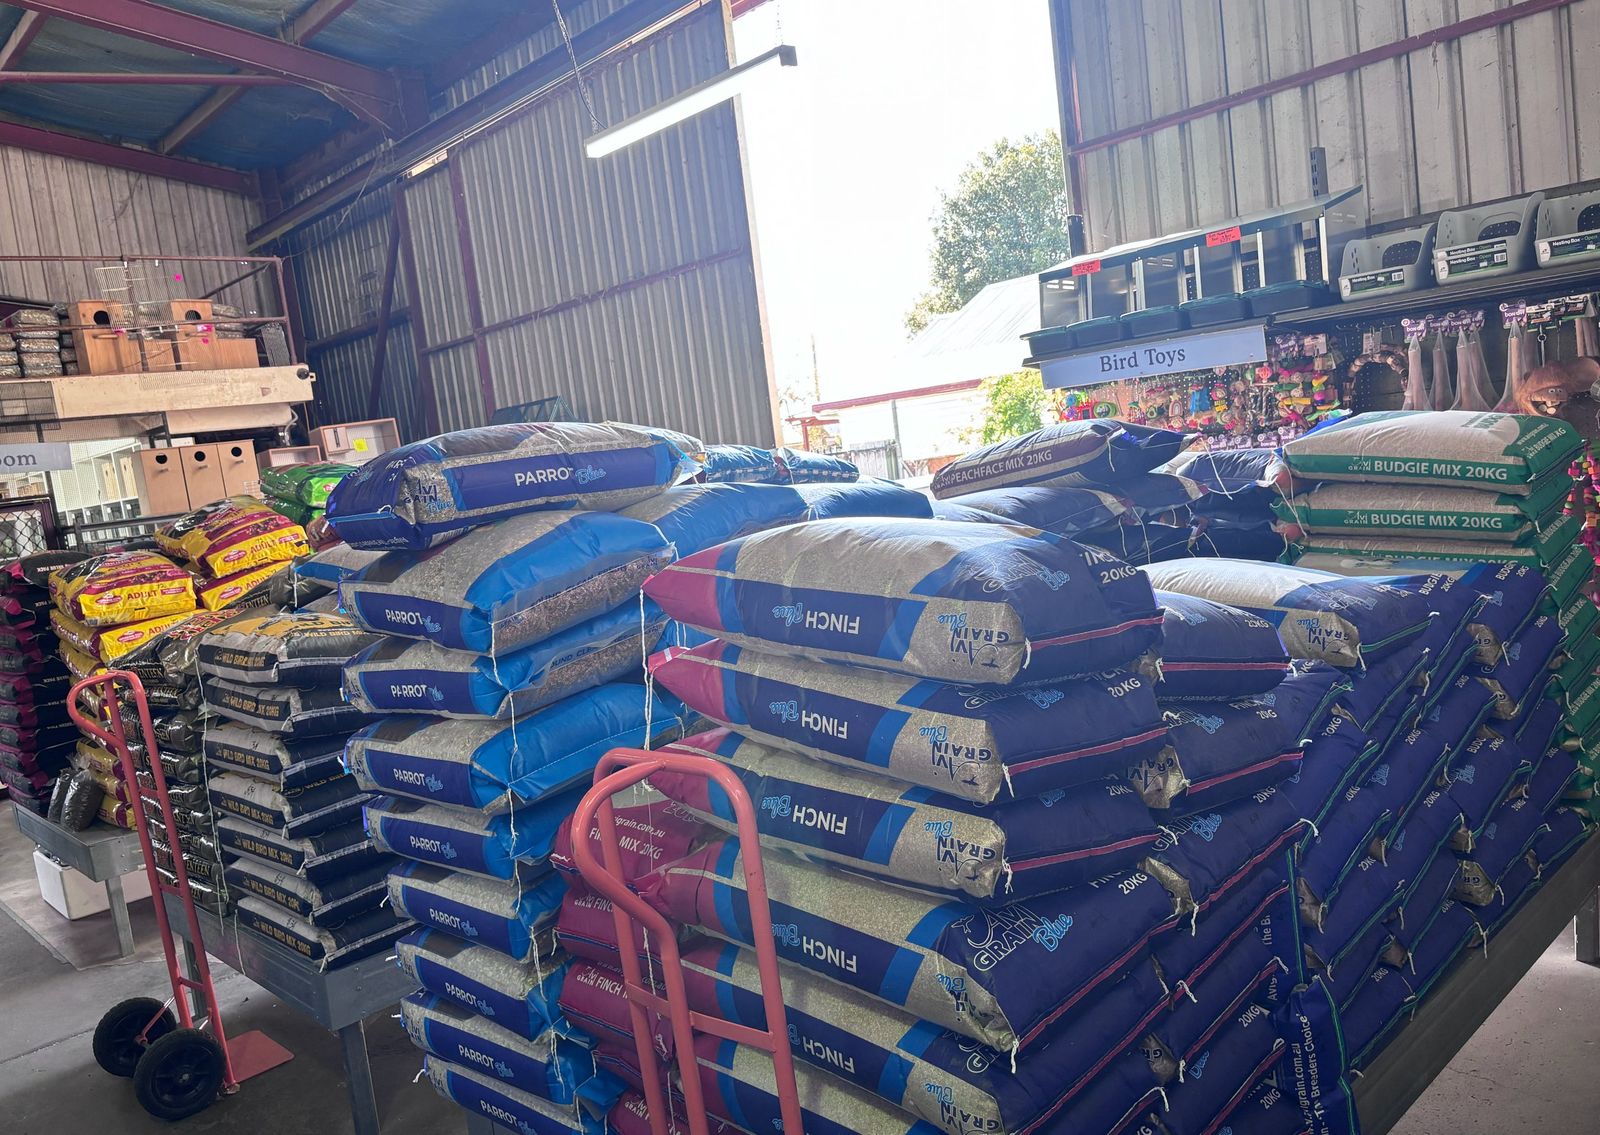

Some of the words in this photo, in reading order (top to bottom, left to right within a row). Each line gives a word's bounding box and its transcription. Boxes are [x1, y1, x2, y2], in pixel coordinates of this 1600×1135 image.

[1100, 350, 1138, 373] Bird
[1144, 347, 1186, 367] Toys
[0, 454, 37, 467] om
[950, 461, 1004, 484] PEACHFACE
[1006, 457, 1024, 471] MIX
[1027, 450, 1052, 466] 20KG
[1374, 460, 1428, 474] BUDGIE
[1432, 463, 1462, 476] MIX
[1466, 466, 1508, 480] 20KG
[575, 464, 606, 484] Blue
[427, 499, 454, 514] Blue
[1371, 513, 1426, 526] BUDGIE
[1429, 514, 1458, 527] MIX
[1461, 516, 1502, 529] 20KG
[250, 538, 277, 555] ADULT
[1100, 566, 1137, 584] 20KG
[1418, 572, 1443, 596] BUDGIE
[1440, 576, 1456, 592] 20KG
[127, 590, 158, 600] ADULT
[386, 609, 423, 625] PARROT
[772, 602, 803, 627] Blue
[806, 610, 860, 635] FINCH
[938, 612, 968, 632] Blue
[1296, 618, 1320, 632] Blue
[954, 627, 1010, 643] GRAIN
[1310, 627, 1350, 642] GRAIN
[1108, 676, 1142, 698] 20KG
[768, 700, 800, 724] Blue
[801, 710, 848, 740] FINCH
[918, 725, 948, 744] Blue
[1404, 729, 1422, 746] 20KG
[932, 740, 992, 761] GRAIN
[393, 768, 426, 786] PARROT
[1253, 785, 1277, 804] 20KG
[1424, 790, 1442, 808] 20KG
[761, 794, 792, 818] Blue
[793, 804, 848, 836] FINCH
[924, 820, 953, 838] Blue
[1191, 814, 1222, 842] Blue
[242, 838, 255, 850] WILD
[410, 836, 442, 854] PARROT
[618, 836, 641, 852] MIX
[937, 836, 997, 861] GRAIN
[250, 880, 264, 893] WILD
[1118, 872, 1148, 896] 20KG
[594, 898, 614, 913] FINC
[260, 920, 274, 935] WILD
[430, 908, 462, 930] PARROT
[974, 917, 1043, 972] GRAIN
[1032, 913, 1074, 952] Blue
[802, 936, 858, 974] FINCH
[596, 976, 623, 996] FINCH
[936, 972, 968, 994] Blue
[445, 982, 478, 1008] PARROT
[1238, 1003, 1261, 1028] 20KG
[1296, 1012, 1315, 1054] Choice'
[458, 1044, 495, 1070] PARROT
[802, 1036, 856, 1074] FINCH
[1307, 1053, 1321, 1098] Breeders
[924, 1082, 954, 1105] Blue
[1260, 1088, 1282, 1110] 20KG
[480, 1100, 518, 1128] PARROT
[940, 1102, 1000, 1131] GRAIN
